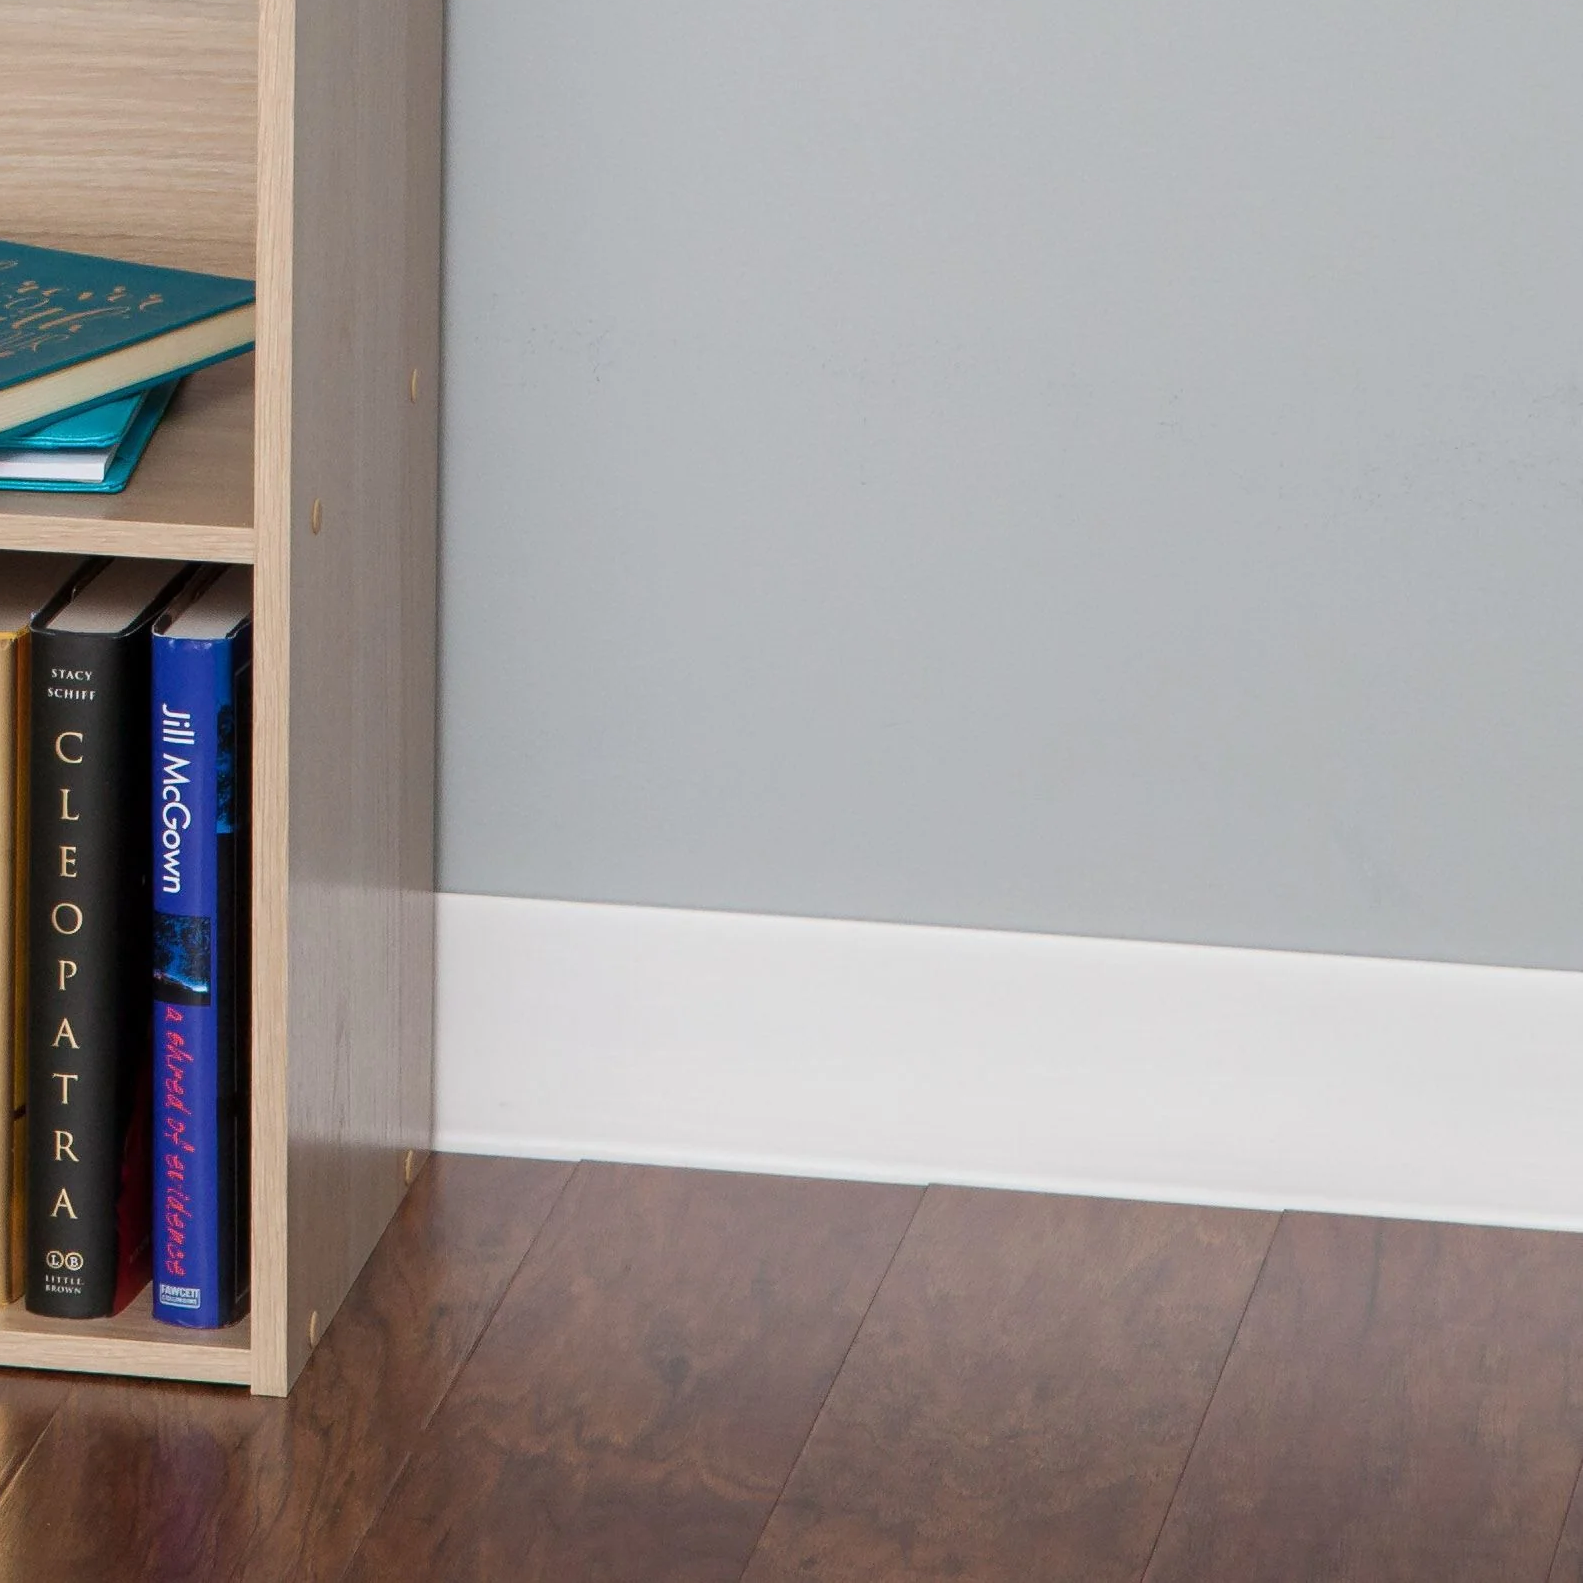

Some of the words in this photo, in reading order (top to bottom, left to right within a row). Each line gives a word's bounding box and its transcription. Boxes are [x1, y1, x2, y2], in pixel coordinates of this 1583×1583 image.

[51, 668, 93, 681] STACY
[47, 687, 97, 701] SCHIFF
[162, 703, 195, 745] Jill
[162, 753, 191, 894] McGown
[51, 730, 84, 1220] CLEOPATRA
[165, 1007, 184, 1022] a
[165, 1031, 194, 1115] shred
[164, 1118, 196, 1153] of
[164, 1155, 194, 1277] evidence
[45, 1285, 82, 1295] BROWN
[162, 1284, 198, 1299] FAWCETT
